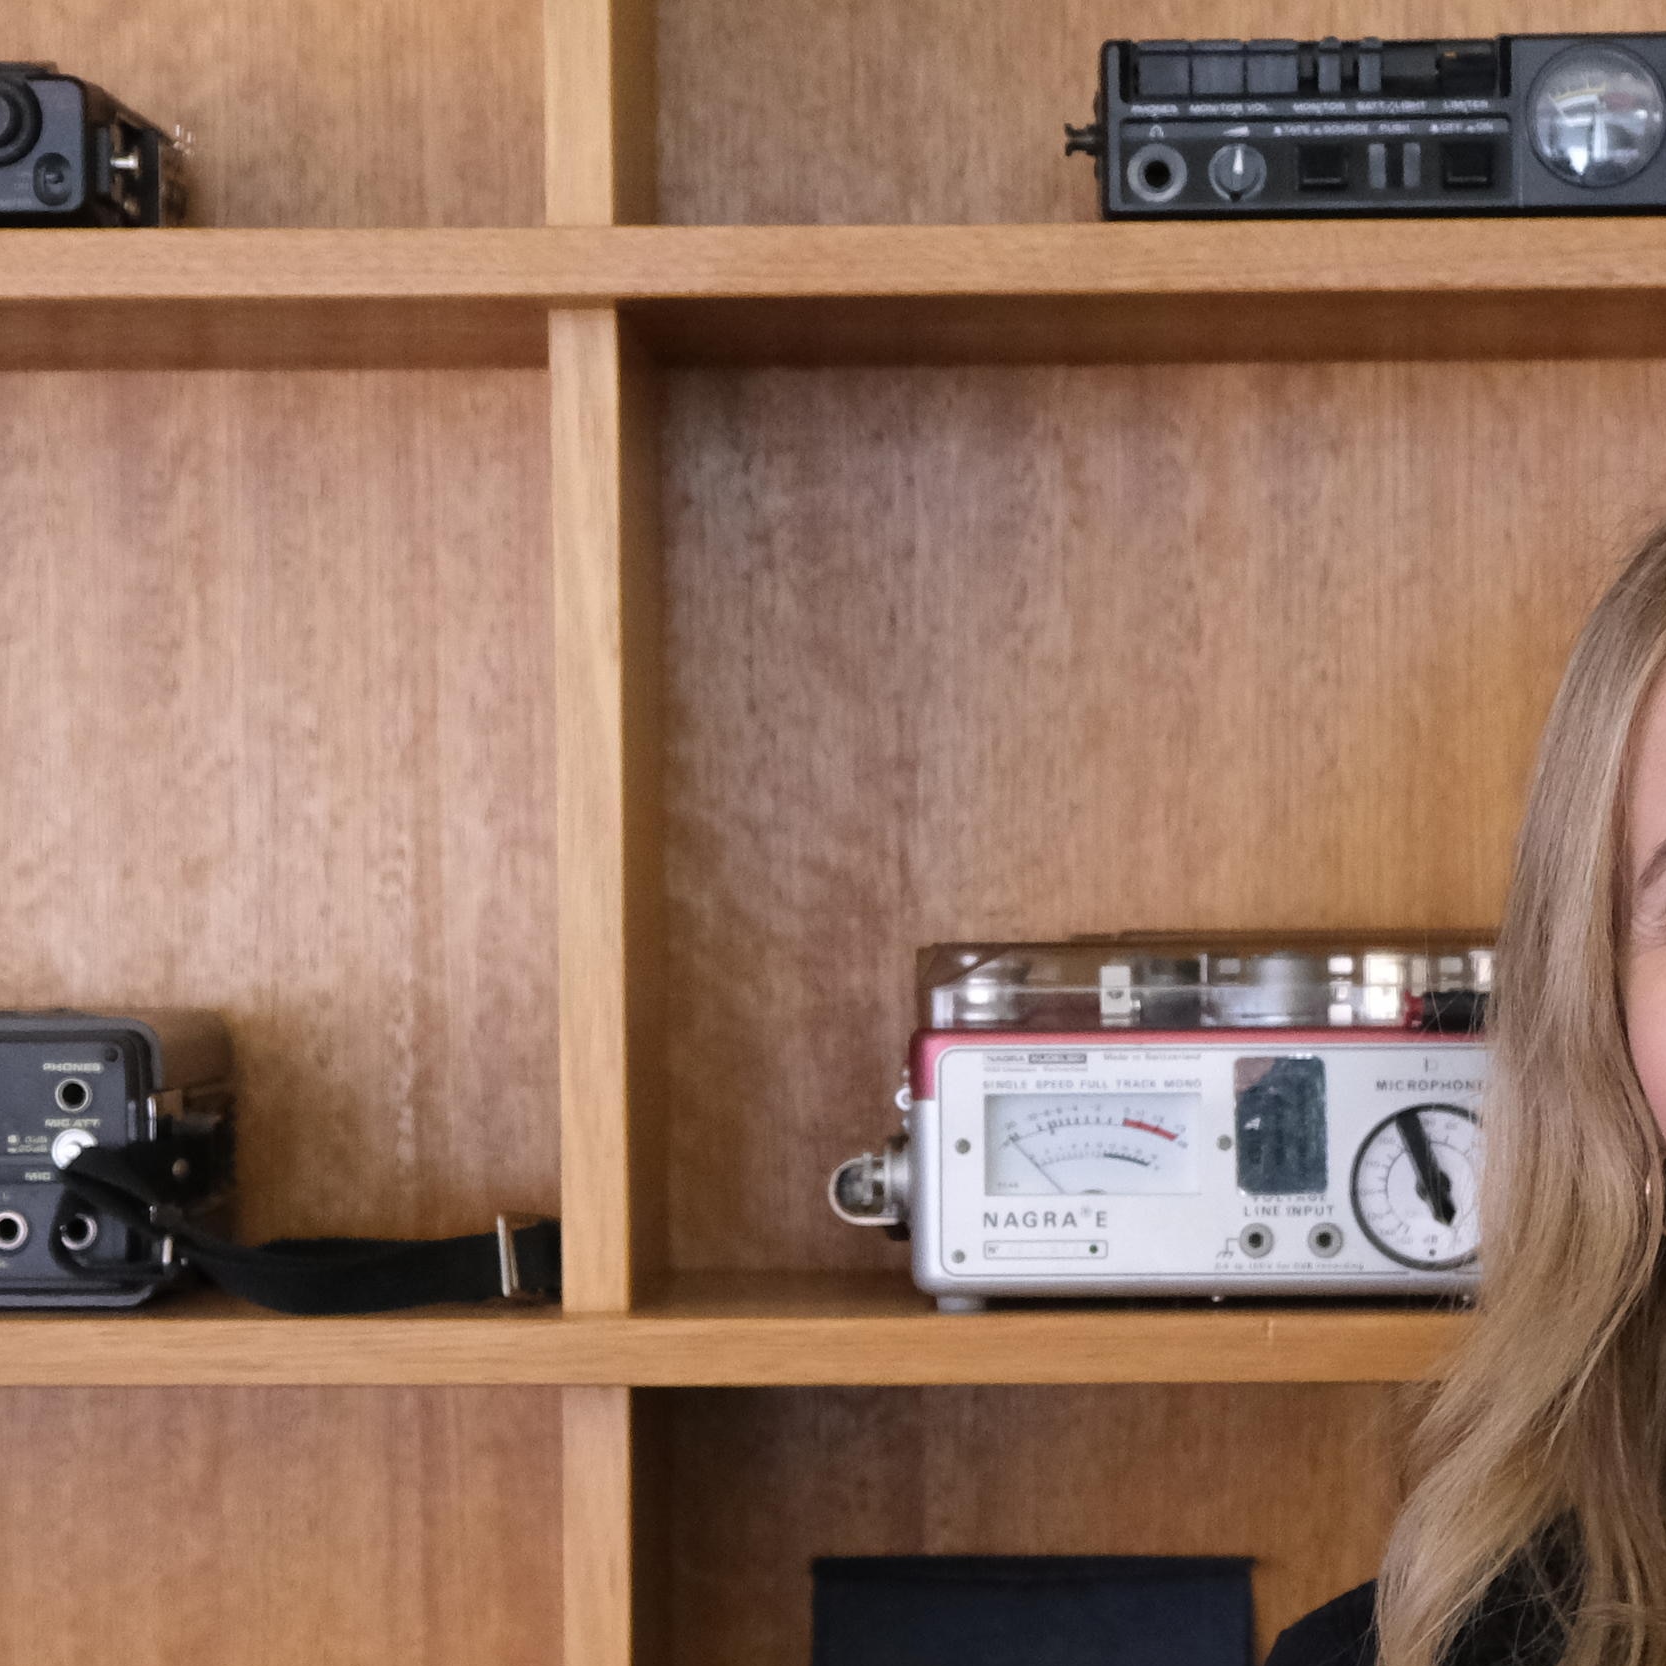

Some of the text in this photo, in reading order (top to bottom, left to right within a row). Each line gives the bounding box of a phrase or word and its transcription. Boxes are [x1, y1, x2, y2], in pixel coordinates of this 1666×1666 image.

[1189, 103, 1243, 115] MONITOR
[1293, 102, 1346, 114] MONITOR
[42, 1062, 104, 1073] PHONES
[983, 1079, 1202, 1089] SINGLE SPEED FULL TRACK MONO
[44, 1118, 70, 1128] MIC
[24, 1171, 52, 1181] MIC
[1244, 1206, 1334, 1216] LINE INPUT
[983, 1211, 1108, 1229] NAGRA E
